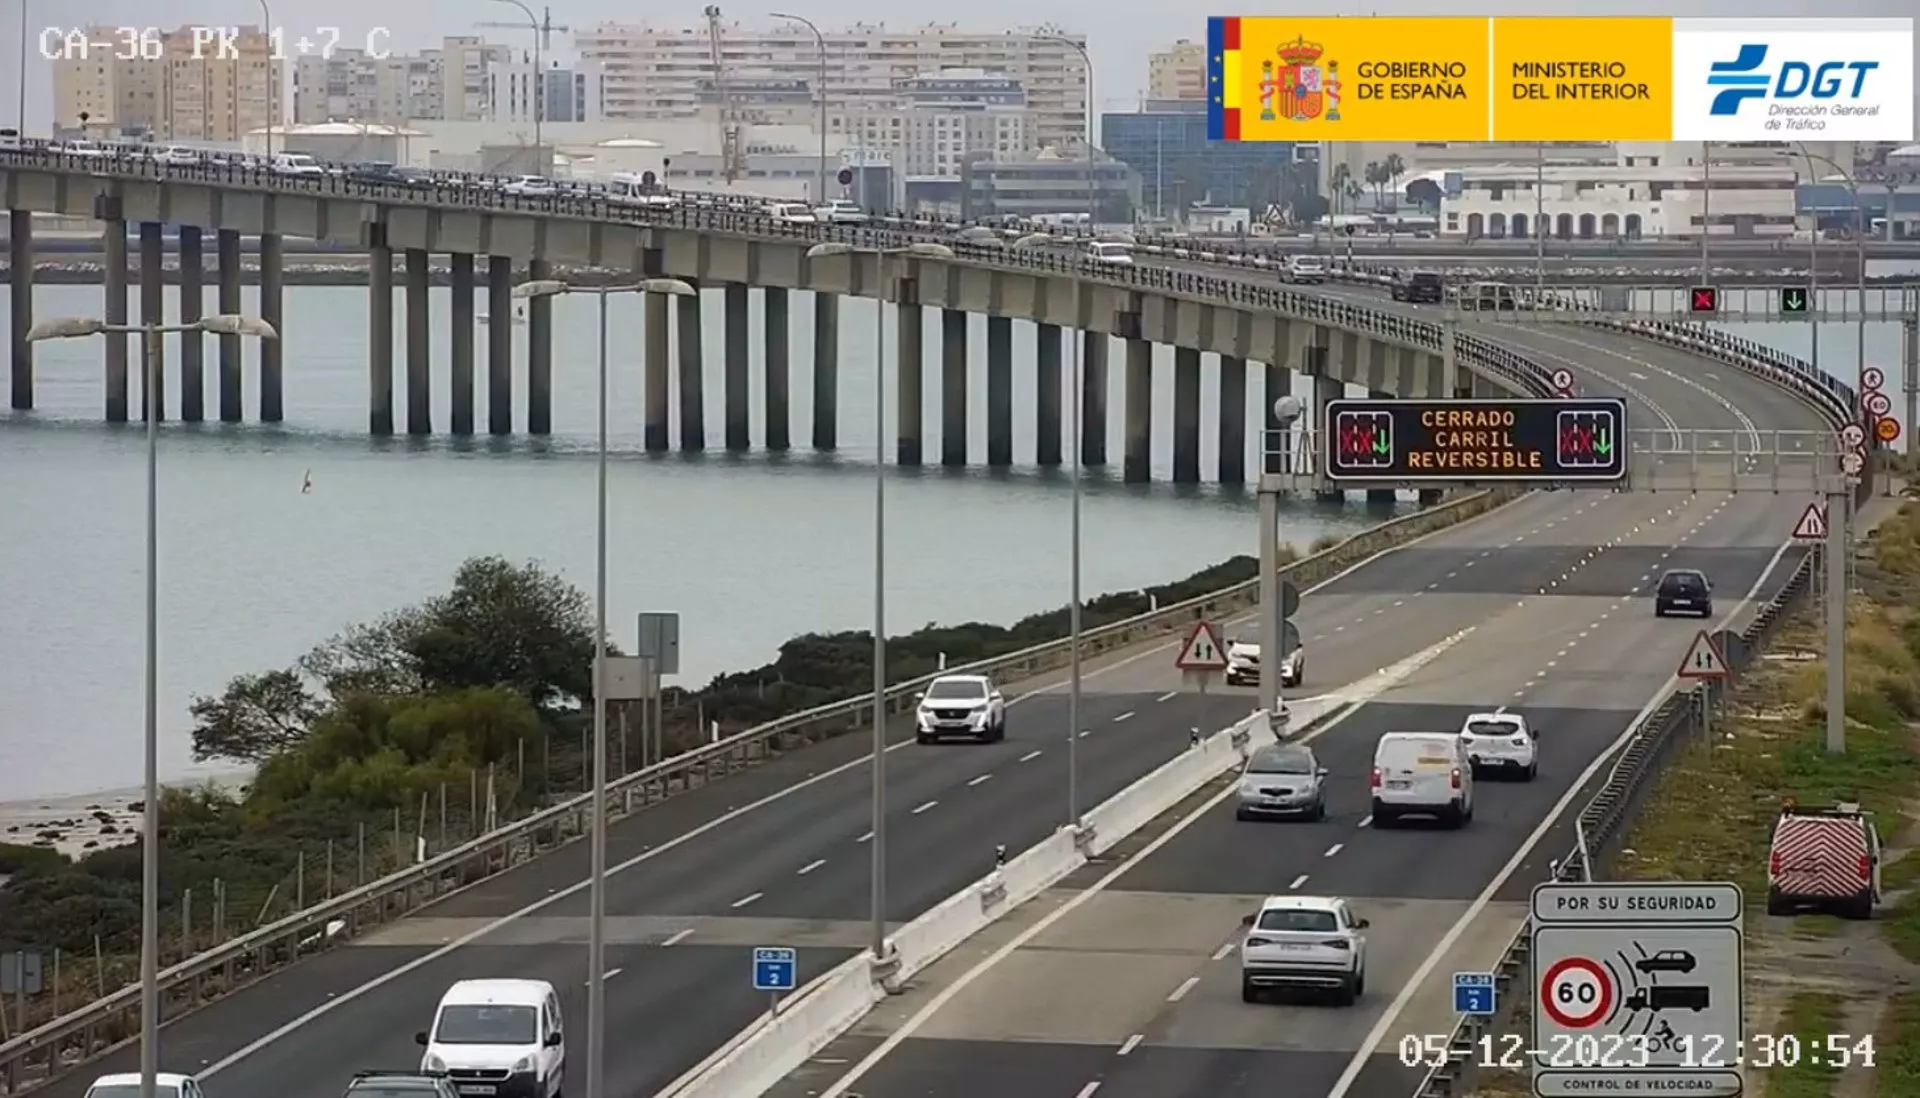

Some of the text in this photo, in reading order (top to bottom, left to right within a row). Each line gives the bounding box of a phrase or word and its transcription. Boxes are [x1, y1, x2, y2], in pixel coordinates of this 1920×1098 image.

[1421, 410, 1515, 428] CERRADO
[1435, 430, 1515, 448] CARRIL
[1408, 451, 1542, 469] REVERSIBLE
[1557, 896, 1717, 910] POR SU SEGURIDAD
[769, 972, 780, 985] 2
[1557, 981, 1597, 1005] 60
[1469, 997, 1479, 1010] 2
[1563, 1079, 1714, 1090] CONTROL DE VELOCIDAD
